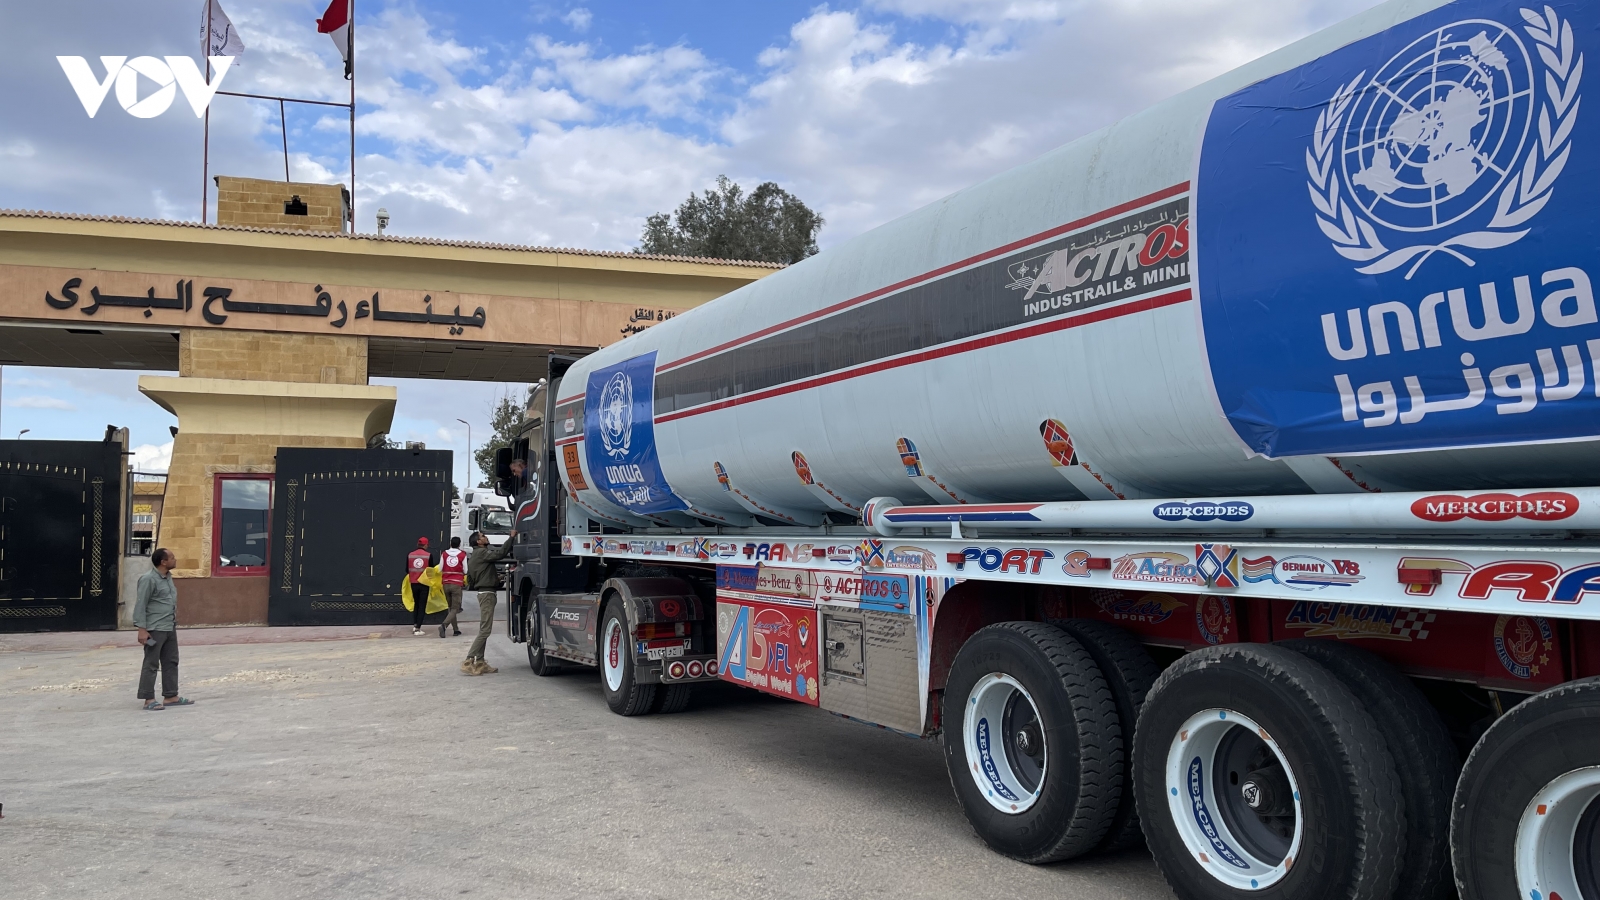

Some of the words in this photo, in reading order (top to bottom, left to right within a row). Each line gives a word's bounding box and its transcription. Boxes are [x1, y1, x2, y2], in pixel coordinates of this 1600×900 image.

[1024, 217, 1189, 300] ACTROS
[1143, 262, 1190, 286] MINI
[202, 284, 347, 328] رفح
[354, 292, 487, 335] ميناء
[1321, 267, 1598, 361] unrwa
[567, 451, 575, 463] 33
[605, 464, 645, 484] unrwa
[1158, 505, 1249, 517] MERCEDES
[1425, 499, 1567, 517] MERCEDES
[956, 547, 1055, 574] PORT
[1137, 558, 1197, 577] ACTRO
[1282, 562, 1326, 574] GERMANY
[1331, 559, 1360, 576] V8
[834, 577, 889, 598] ACTROS
[550, 607, 580, 621] ACTROS
[1113, 613, 1153, 622] SPORT
[1334, 614, 1392, 634] Models
[979, 723, 1017, 801] MERCEDES
[1191, 762, 1246, 868] MERCEDES
